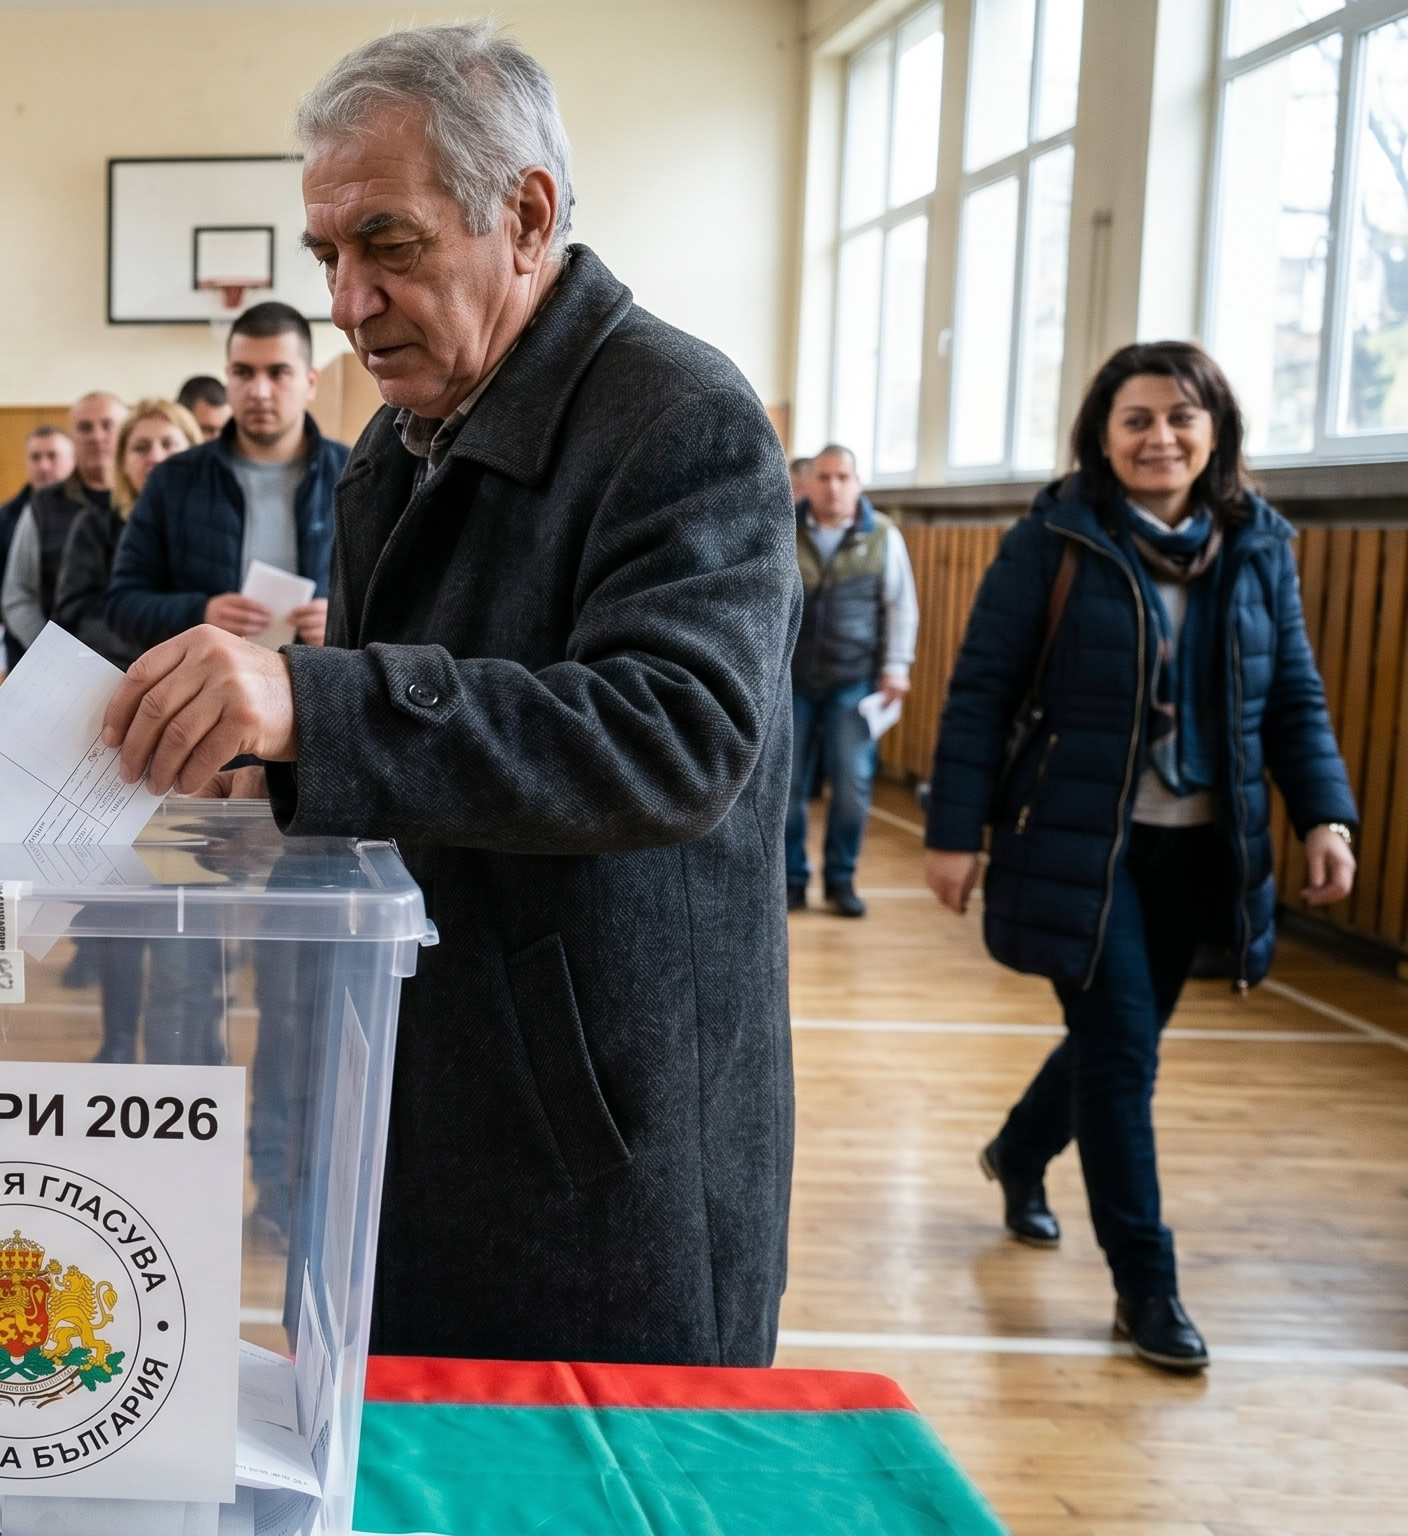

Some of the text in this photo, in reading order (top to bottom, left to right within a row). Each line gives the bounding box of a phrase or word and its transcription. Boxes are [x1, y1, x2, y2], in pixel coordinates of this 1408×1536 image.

[85, 1095, 219, 1141] 2026
[39, 1175, 167, 1293] ГЛАСУВА
[32, 1357, 169, 1469] БЪЛГАРИЯ
